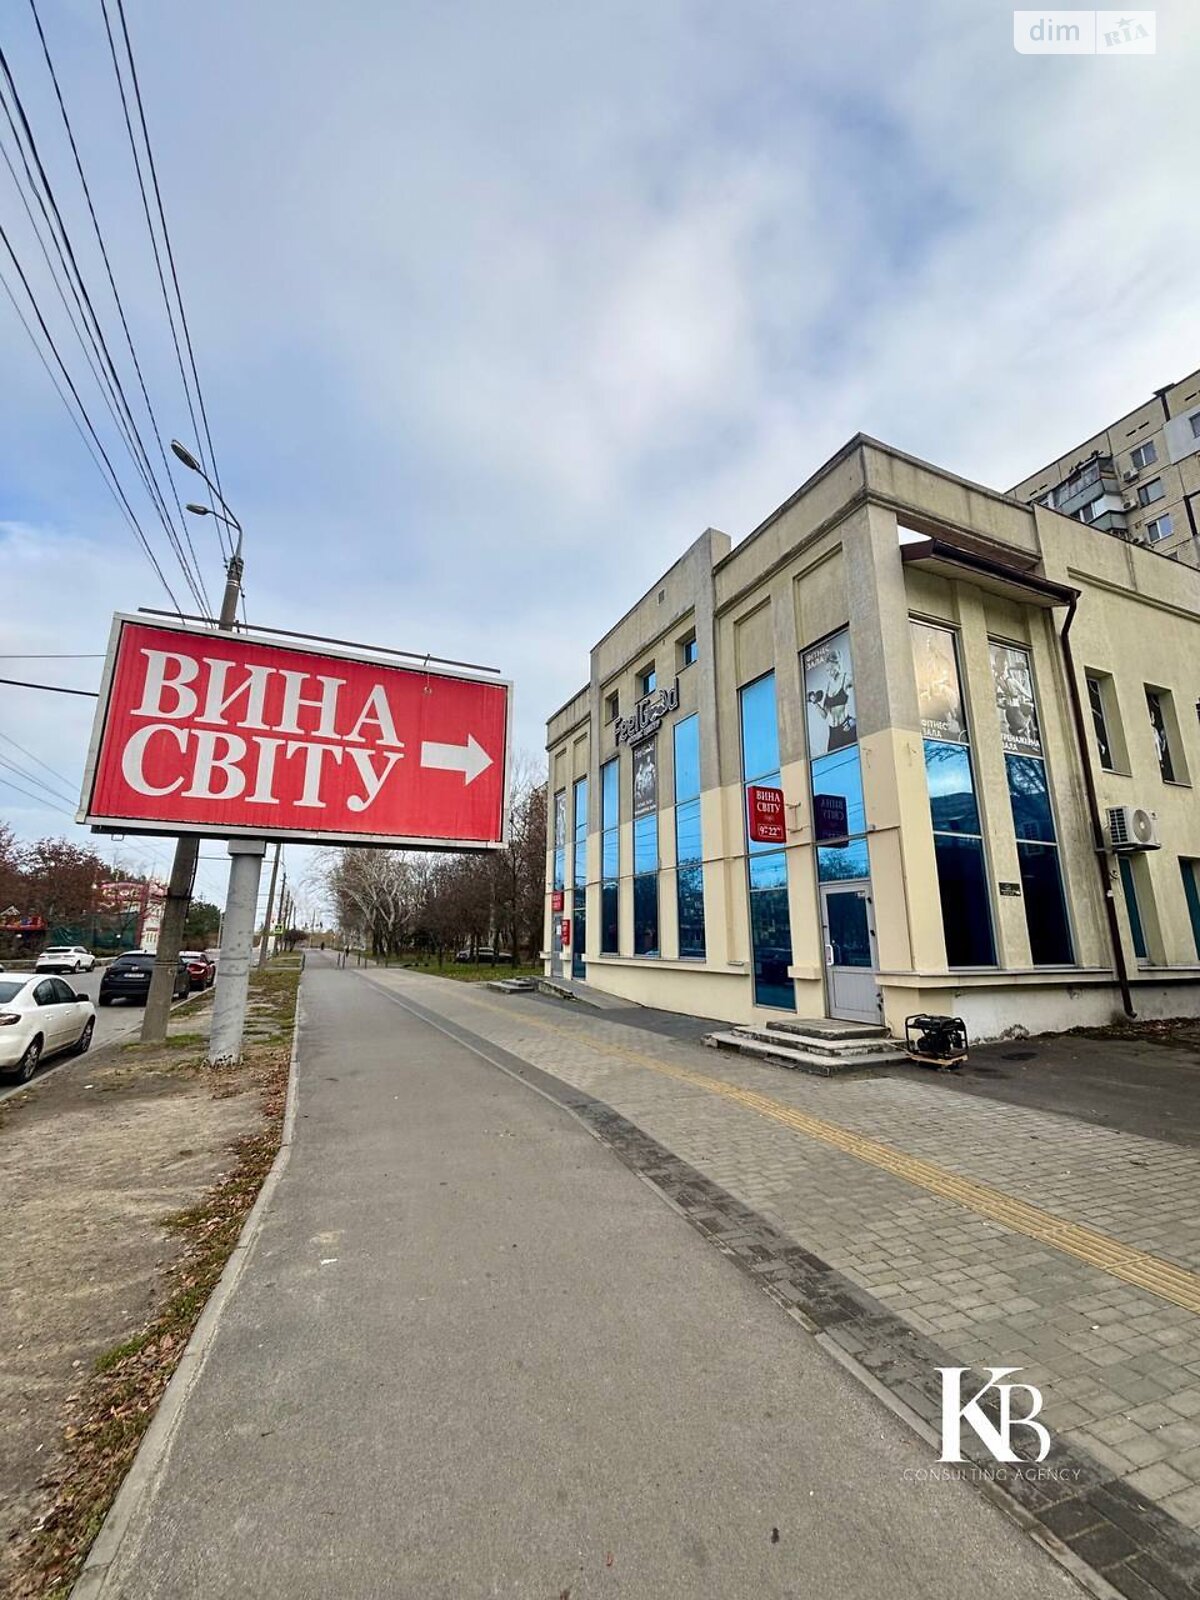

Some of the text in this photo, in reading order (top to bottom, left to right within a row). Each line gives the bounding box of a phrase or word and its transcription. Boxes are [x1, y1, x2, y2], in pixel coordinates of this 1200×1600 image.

[130, 648, 405, 748] ВИНА
[121, 723, 405, 813] СВІТУ
[756, 790, 780, 802] ВИНА
[757, 802, 780, 813] СВІТУ
